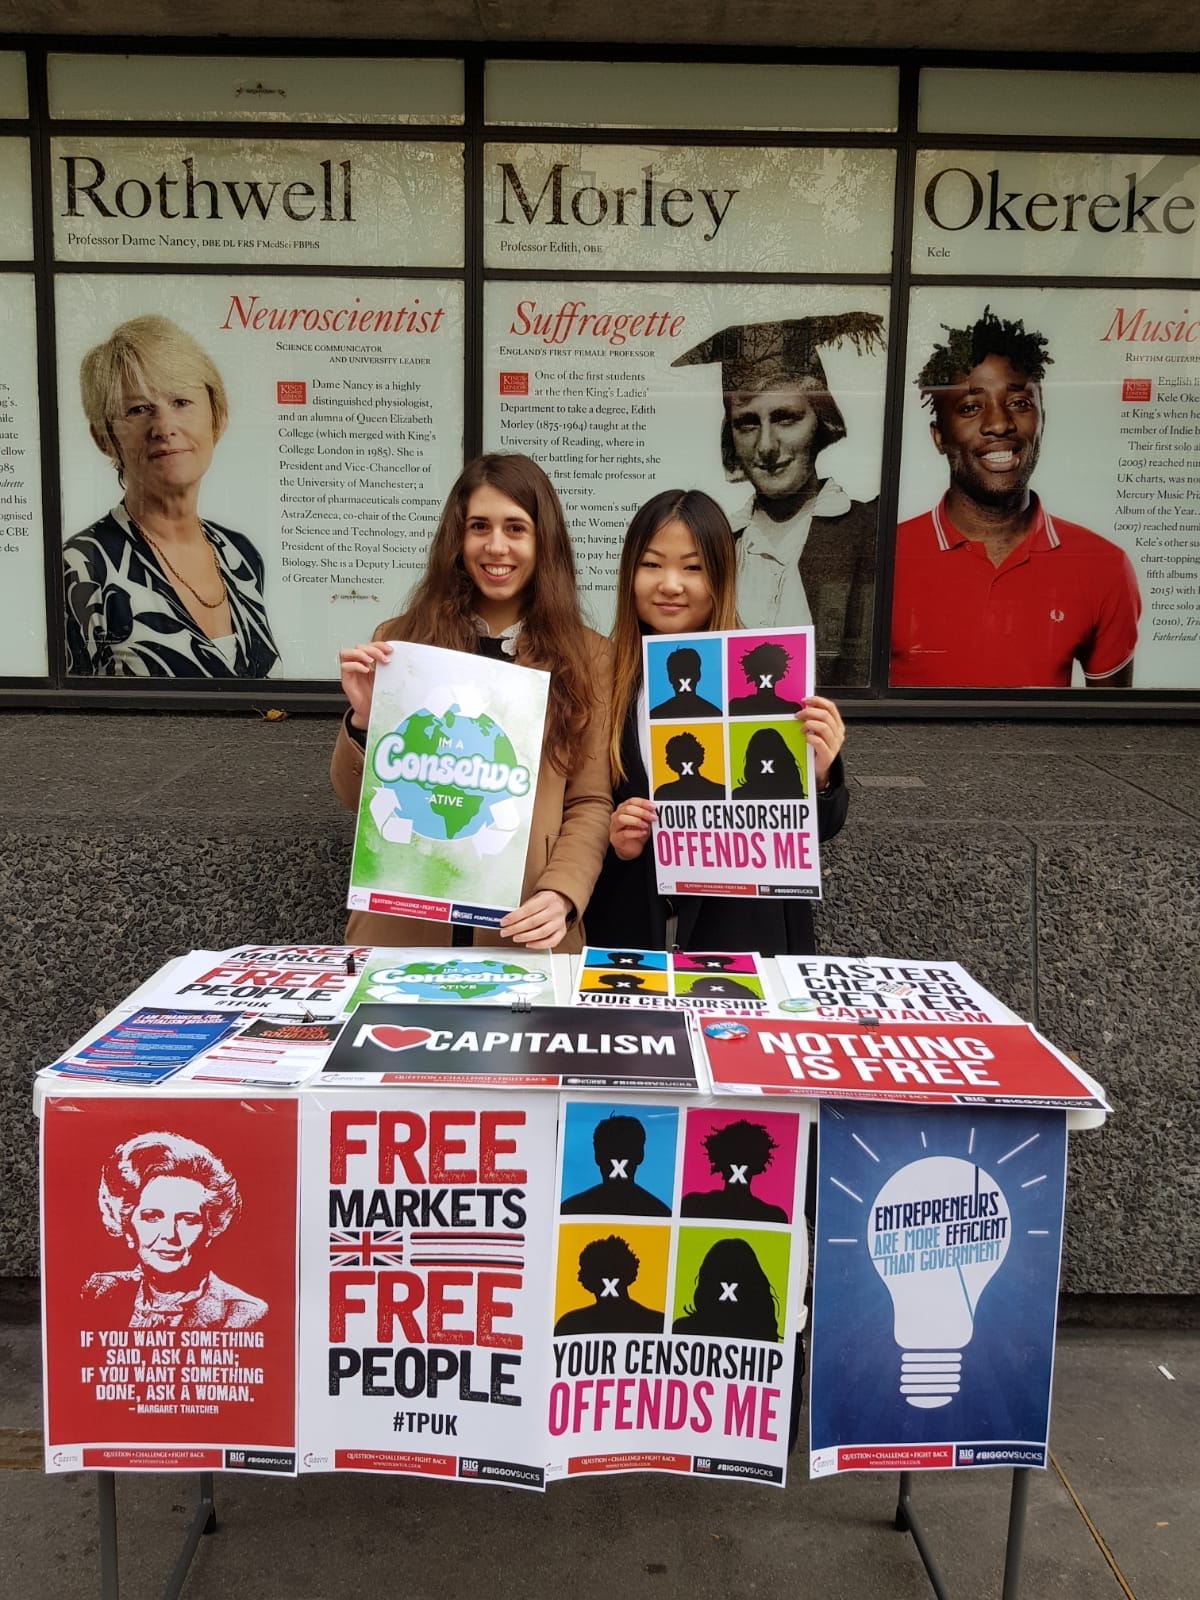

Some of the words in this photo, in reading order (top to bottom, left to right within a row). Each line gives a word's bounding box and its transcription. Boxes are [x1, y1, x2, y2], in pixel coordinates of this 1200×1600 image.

[59, 156, 356, 222] Rothwell
[496, 162, 740, 241] Morley
[924, 167, 1195, 234] Okereke
[67, 232, 119, 247] Professor
[121, 233, 156, 247] Dame
[159, 234, 199, 251] Nancy,
[202, 239, 220, 248] DBE
[223, 239, 235, 248] DL
[237, 239, 255, 248] FRS
[500, 241, 547, 253] Professor
[550, 242, 580, 254] Edith,
[584, 244, 602, 253] OBE
[927, 247, 951, 258] Kele
[220, 295, 445, 334] Neuroscientist
[510, 301, 685, 344] Suffragette
[313, 380, 340, 389] Dame
[343, 380, 373, 391] Nancy
[392, 382, 421, 392] highly
[313, 396, 372, 407] distinguished
[375, 398, 432, 408] physiologist,
[500, 403, 554, 414] Department
[568, 405, 587, 414] take
[596, 405, 628, 415] degree,
[631, 405, 655, 414] Edith
[278, 413, 294, 421] and
[310, 414, 343, 422] alumna
[346, 413, 355, 421] of
[357, 413, 388, 424] Queen
[390, 414, 433, 424] Elizabeth
[500, 421, 534, 431] Morley
[589, 421, 618, 432] taught
[632, 423, 646, 431] the
[279, 428, 314, 439] College
[317, 429, 346, 439] (which
[349, 430, 383, 440] merged
[385, 431, 405, 439] with
[408, 431, 436, 441] King's
[500, 437, 547, 447] University
[551, 437, 560, 446] of
[563, 437, 603, 448] Reading,
[606, 438, 634, 447] where
[636, 439, 644, 447] in
[1118, 458, 1146, 469] (2005)
[1148, 458, 1184, 468] reached
[1117, 474, 1133, 483] UK
[1135, 474, 1165, 484] charts,
[1115, 506, 1145, 515] Album
[1147, 505, 1156, 515] of
[1158, 506, 1171, 515] the
[1114, 523, 1141, 532] (2007)
[1144, 523, 1177, 531] reached
[454, 737, 464, 749] A
[375, 733, 529, 795] Conserve
[656, 805, 697, 829] YOUR
[703, 805, 809, 830] CENSORSHIP
[656, 831, 767, 869] OFFENDS
[774, 832, 812, 869] ME
[194, 968, 356, 990] FREE
[798, 963, 957, 982] FASTER
[175, 984, 339, 1002] PEOPLE
[579, 993, 631, 1005] YOUR
[638, 997, 767, 1010] CENSORSHIP
[215, 1000, 272, 1008] #TPUK
[816, 1006, 992, 1023] CAPITALISM
[352, 1024, 372, 1047] I
[426, 1030, 676, 1056] CAPITALISM
[758, 1032, 996, 1060] NOTHING
[785, 1055, 841, 1080] IS
[851, 1057, 1000, 1086] FREE
[329, 1110, 527, 1185] FREE
[328, 1188, 526, 1228] MARKETS
[875, 1192, 999, 1232] ENTREPRENEURS
[875, 1232, 898, 1256] ARE
[905, 1228, 940, 1250] MORE
[946, 1218, 1007, 1246] EFFICIENT
[873, 1253, 914, 1275] THAN
[921, 1241, 1002, 1270] GOVERNMENT
[328, 1270, 523, 1350] FREE
[81, 1331, 93, 1347] IF
[100, 1331, 128, 1347] YOU
[135, 1331, 175, 1347] WANT
[181, 1331, 264, 1348] SOMETHING
[107, 1349, 146, 1366] SAID,
[152, 1349, 180, 1365] ASK
[187, 1350, 196, 1365] A
[201, 1350, 239, 1367] MAN;
[554, 1340, 616, 1377] YOUR
[625, 1340, 783, 1383] CENSORSHIP
[82, 1368, 94, 1383] IF
[100, 1367, 128, 1383] YOU
[135, 1367, 175, 1383] WANT
[181, 1367, 264, 1384] SOMETHING
[328, 1347, 522, 1407] PEOPLE
[96, 1384, 140, 1403] DONE,
[146, 1385, 175, 1400] ASK
[181, 1385, 190, 1401] A
[196, 1386, 254, 1401] WOMAN.
[181, 1405, 219, 1414] THATCHER
[548, 1378, 714, 1437] OFFENDS
[723, 1383, 780, 1442] ME
[392, 1411, 458, 1437] #TPUK
[976, 1451, 1042, 1459] #BIGGOVSUCKS
[463, 1460, 478, 1469] BIG
[482, 1467, 540, 1481] #BIGGOVSUCKS
[717, 1464, 773, 1477] #BIGGOVSUCKS
